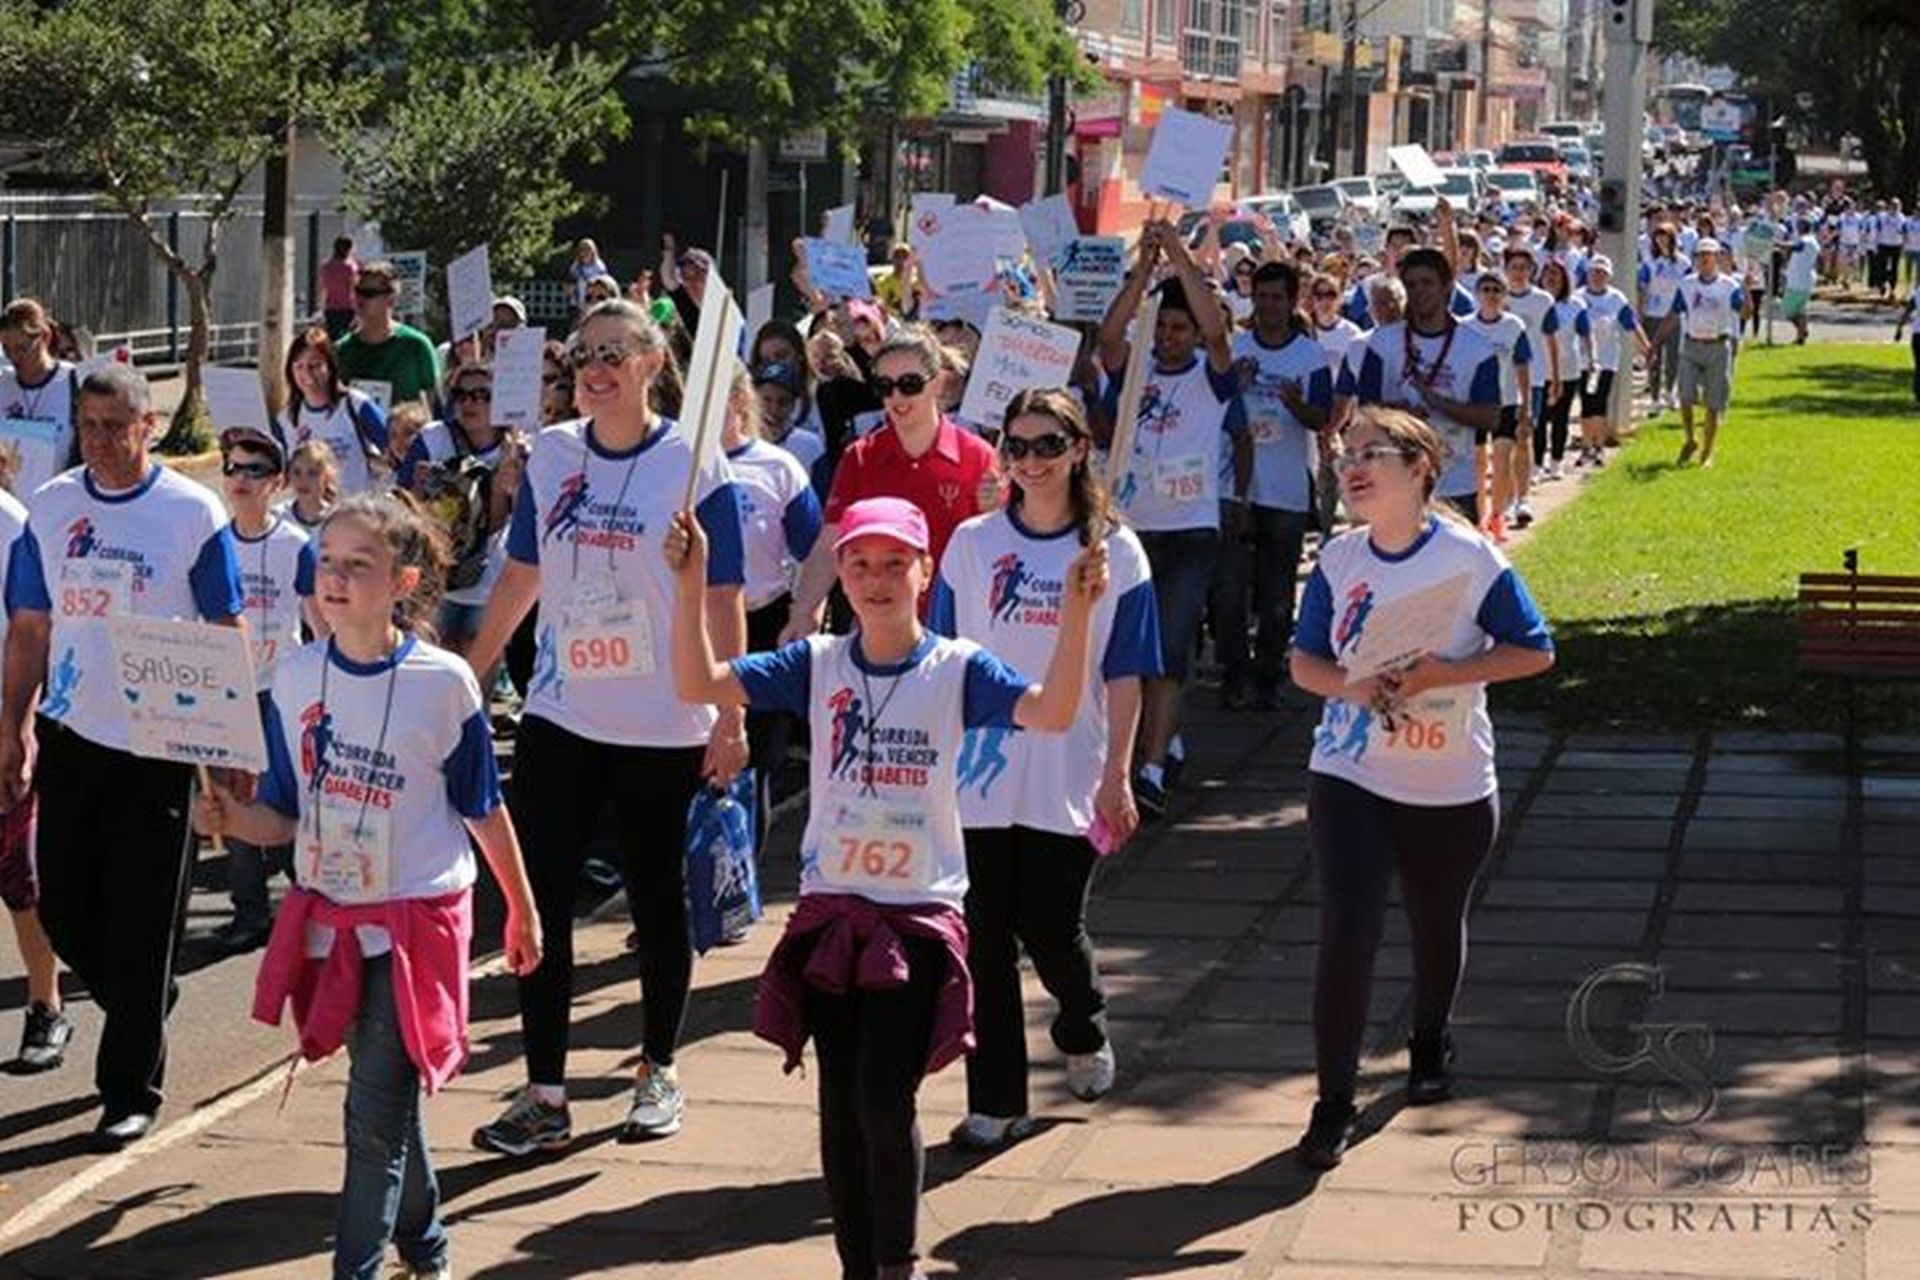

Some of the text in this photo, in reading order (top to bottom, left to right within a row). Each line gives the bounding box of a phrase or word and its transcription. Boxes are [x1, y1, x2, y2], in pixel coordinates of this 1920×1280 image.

[576, 531, 636, 551] DIABETES
[61, 588, 110, 617] 852
[569, 637, 629, 669] 690
[872, 727, 930, 747] CORRIDA
[335, 742, 397, 768] CORRIDA
[888, 748, 939, 767] VENCER
[352, 765, 406, 790] VENCER
[861, 765, 929, 787] DIABETES
[325, 778, 392, 809] DIABETES
[841, 837, 914, 879] 762
